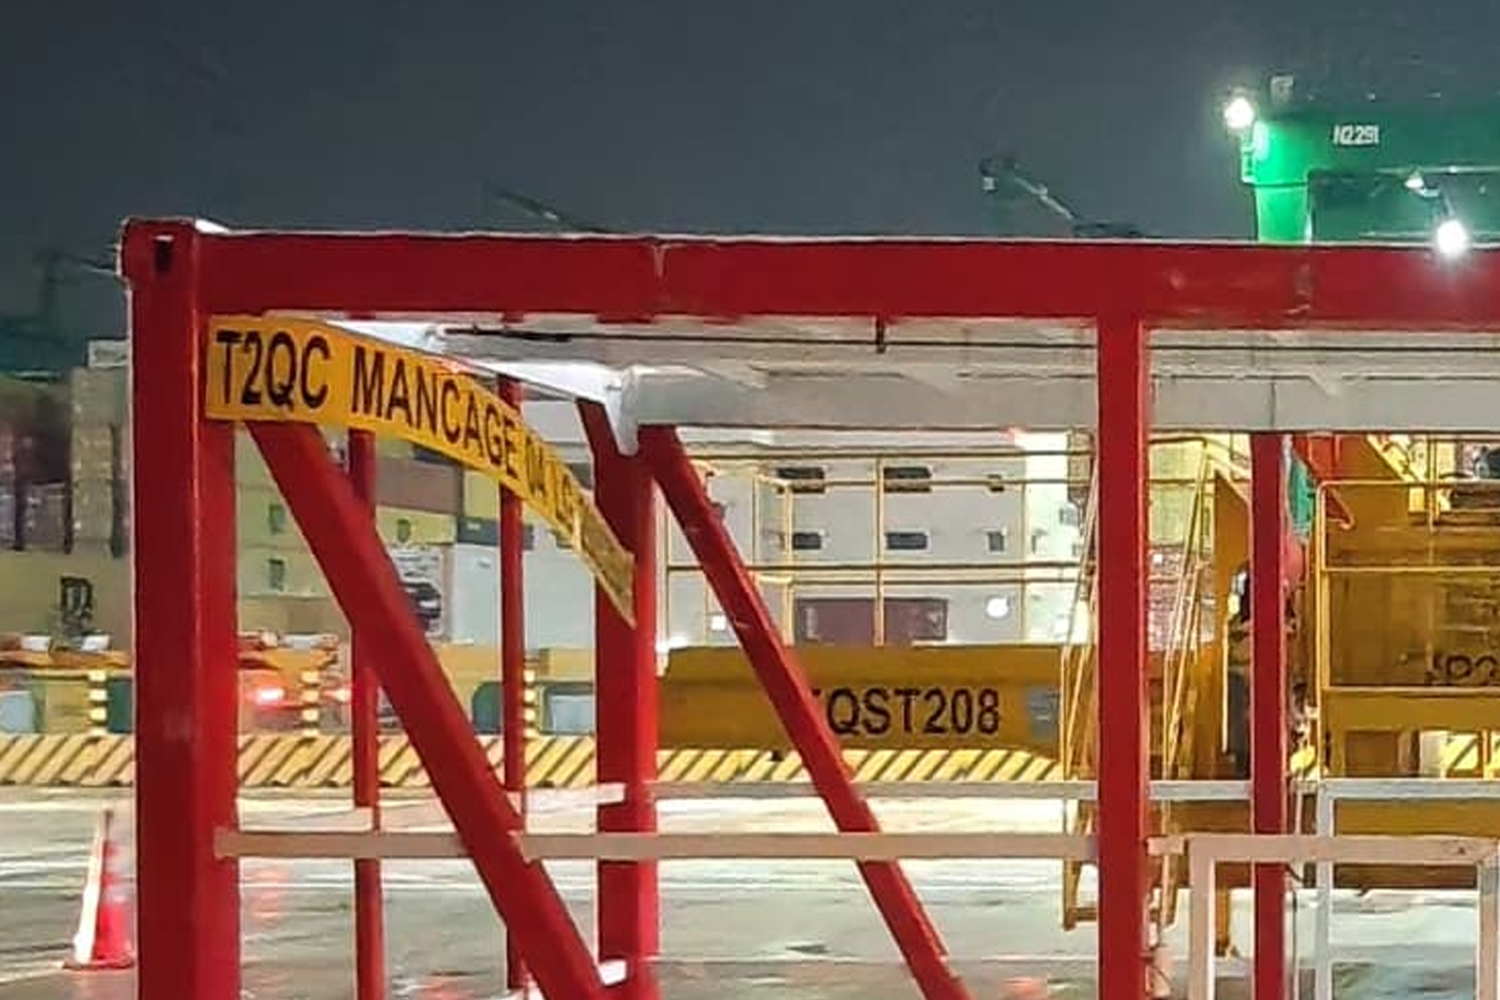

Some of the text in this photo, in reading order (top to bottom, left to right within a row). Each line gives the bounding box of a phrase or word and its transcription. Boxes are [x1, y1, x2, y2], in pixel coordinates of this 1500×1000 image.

[215, 330, 520, 480] T2QC MANCAGE
[811, 687, 1000, 736] QST208
